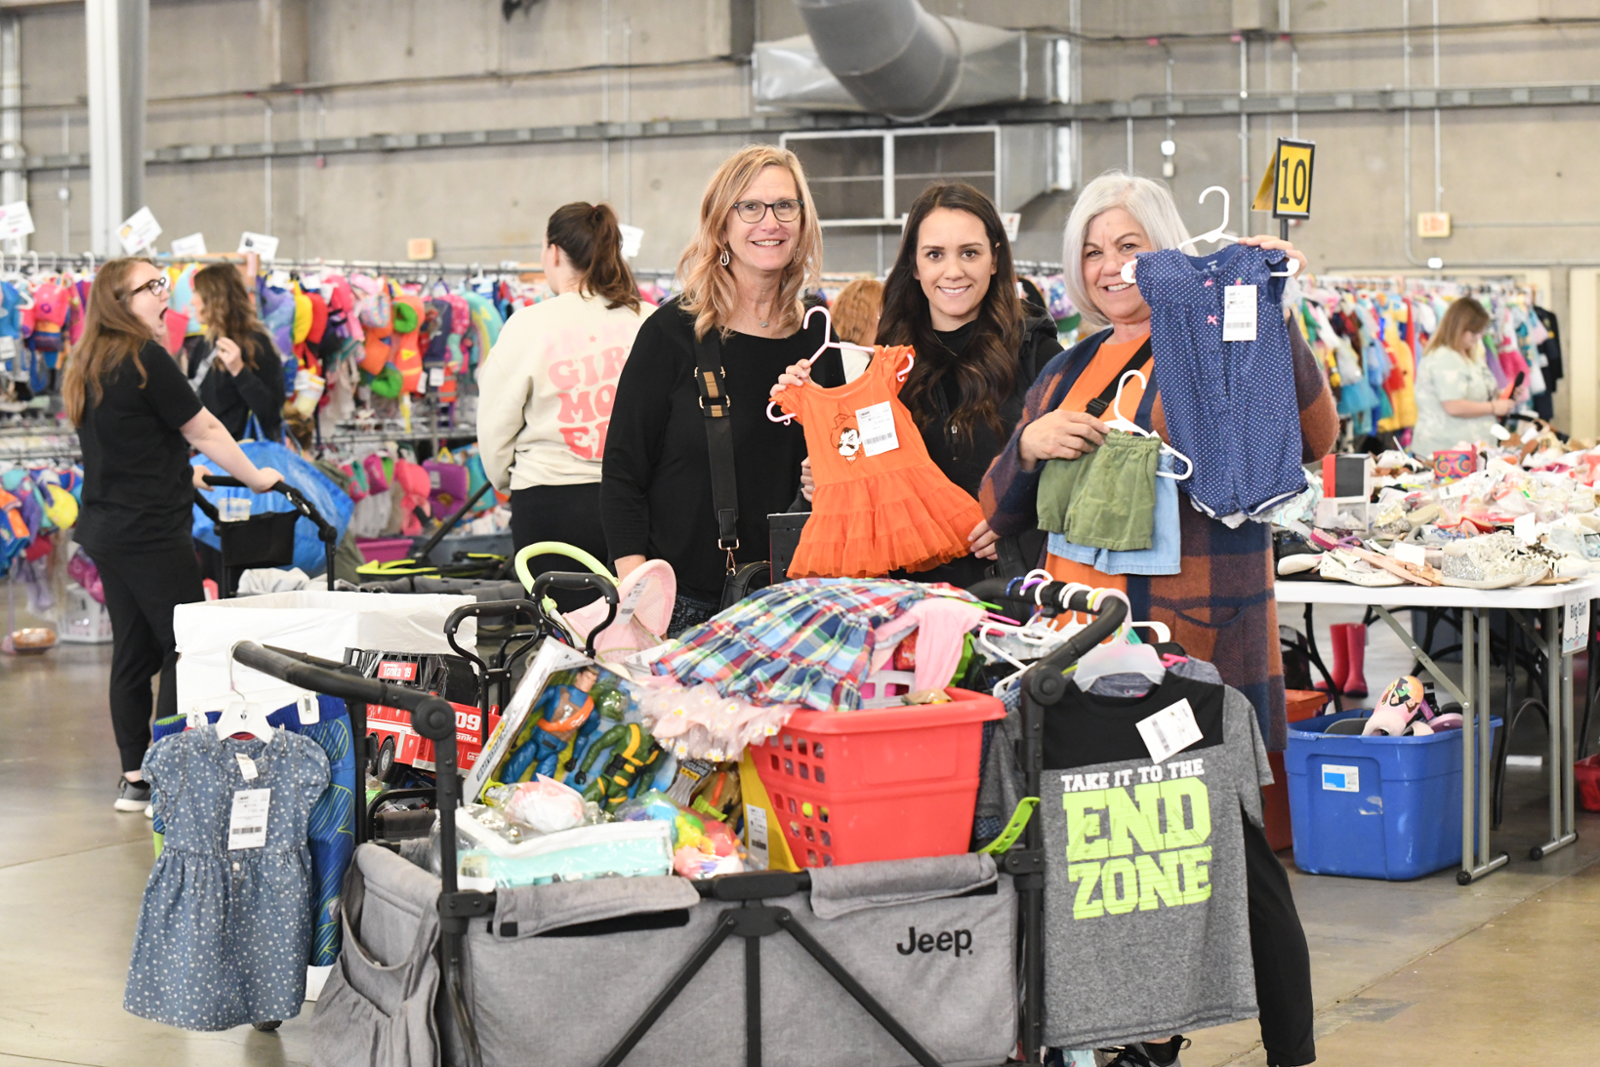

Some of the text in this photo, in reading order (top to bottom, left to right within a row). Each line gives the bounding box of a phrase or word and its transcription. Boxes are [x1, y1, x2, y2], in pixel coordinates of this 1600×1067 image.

[1280, 157, 1307, 206] 10
[383, 663, 402, 678] Tonka
[454, 711, 481, 731] 09
[1061, 758, 1205, 792] TAKE IT TO THE
[1063, 777, 1212, 862] END
[1068, 845, 1212, 920] ZONE
[896, 926, 972, 957] Jeep
